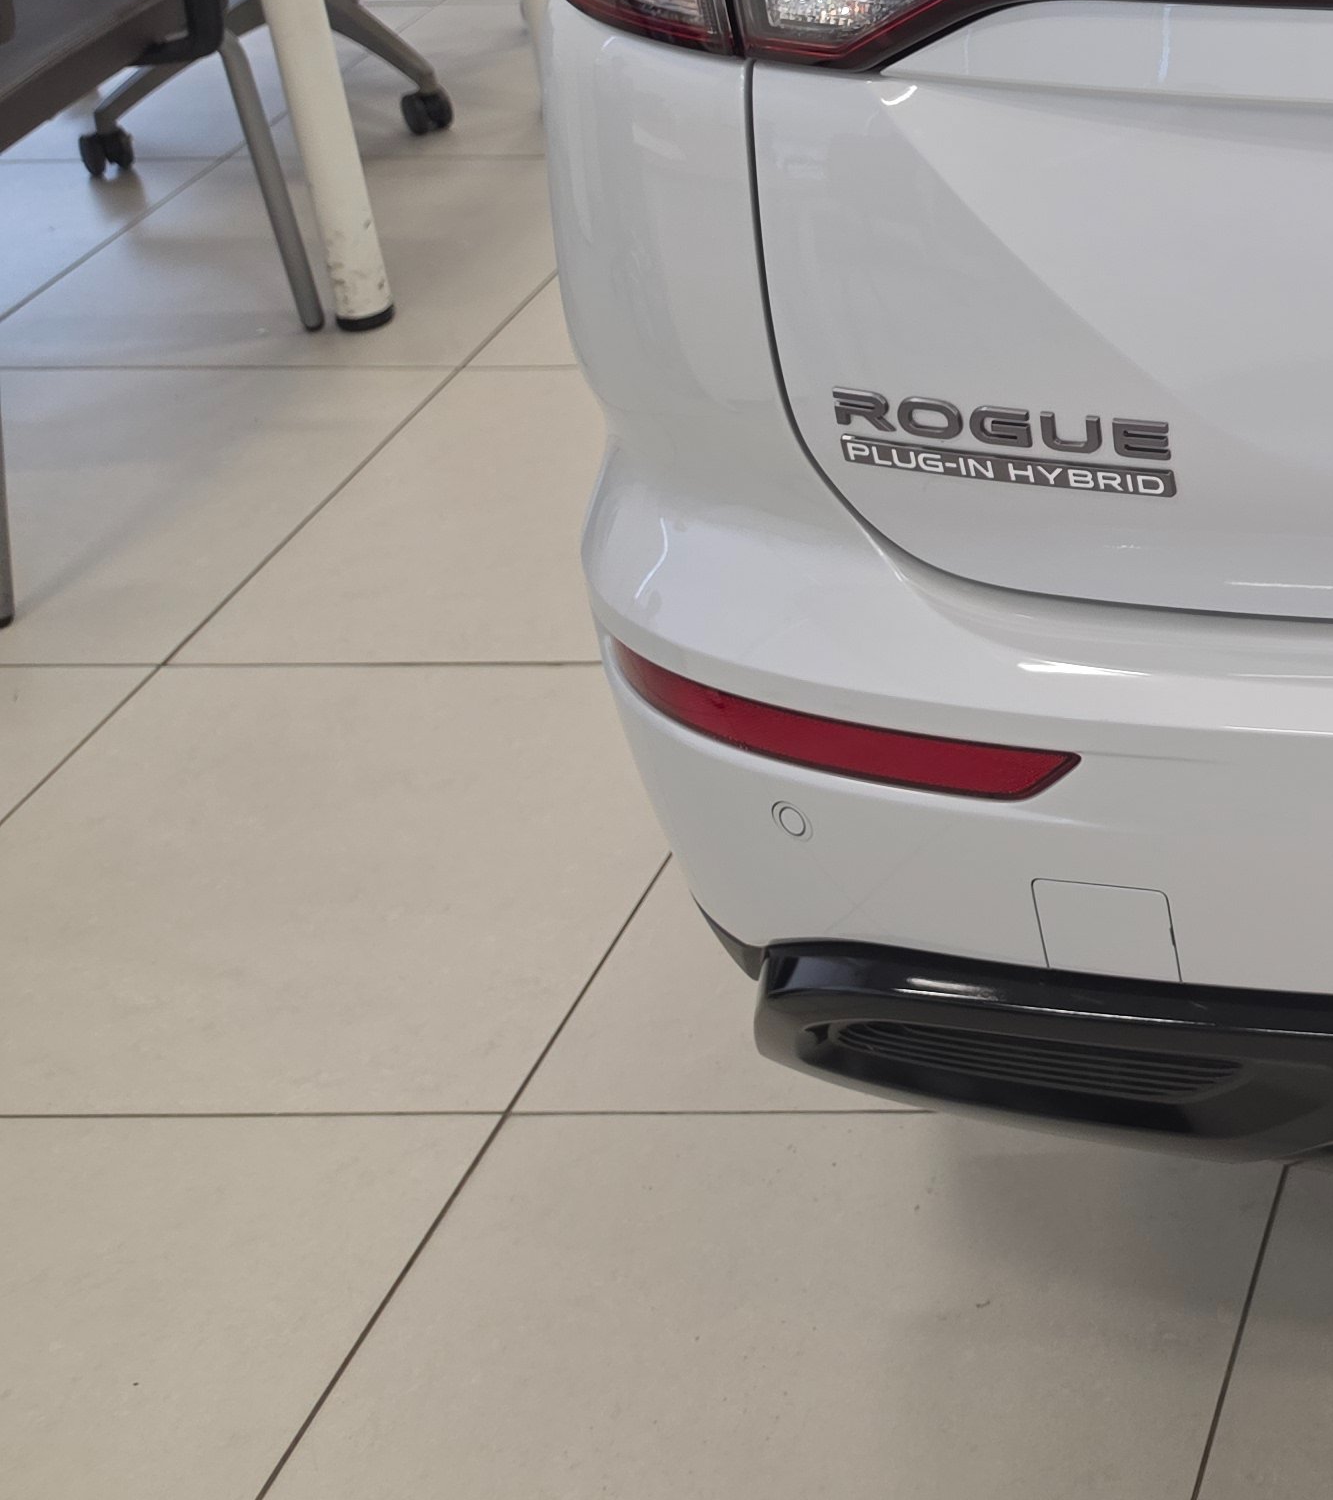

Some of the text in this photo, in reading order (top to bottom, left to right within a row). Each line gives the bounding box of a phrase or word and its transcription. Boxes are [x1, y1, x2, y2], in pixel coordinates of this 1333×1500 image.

[831, 385, 1172, 461] ROGUE
[845, 441, 1167, 496] PLUG-IN HYBRID
